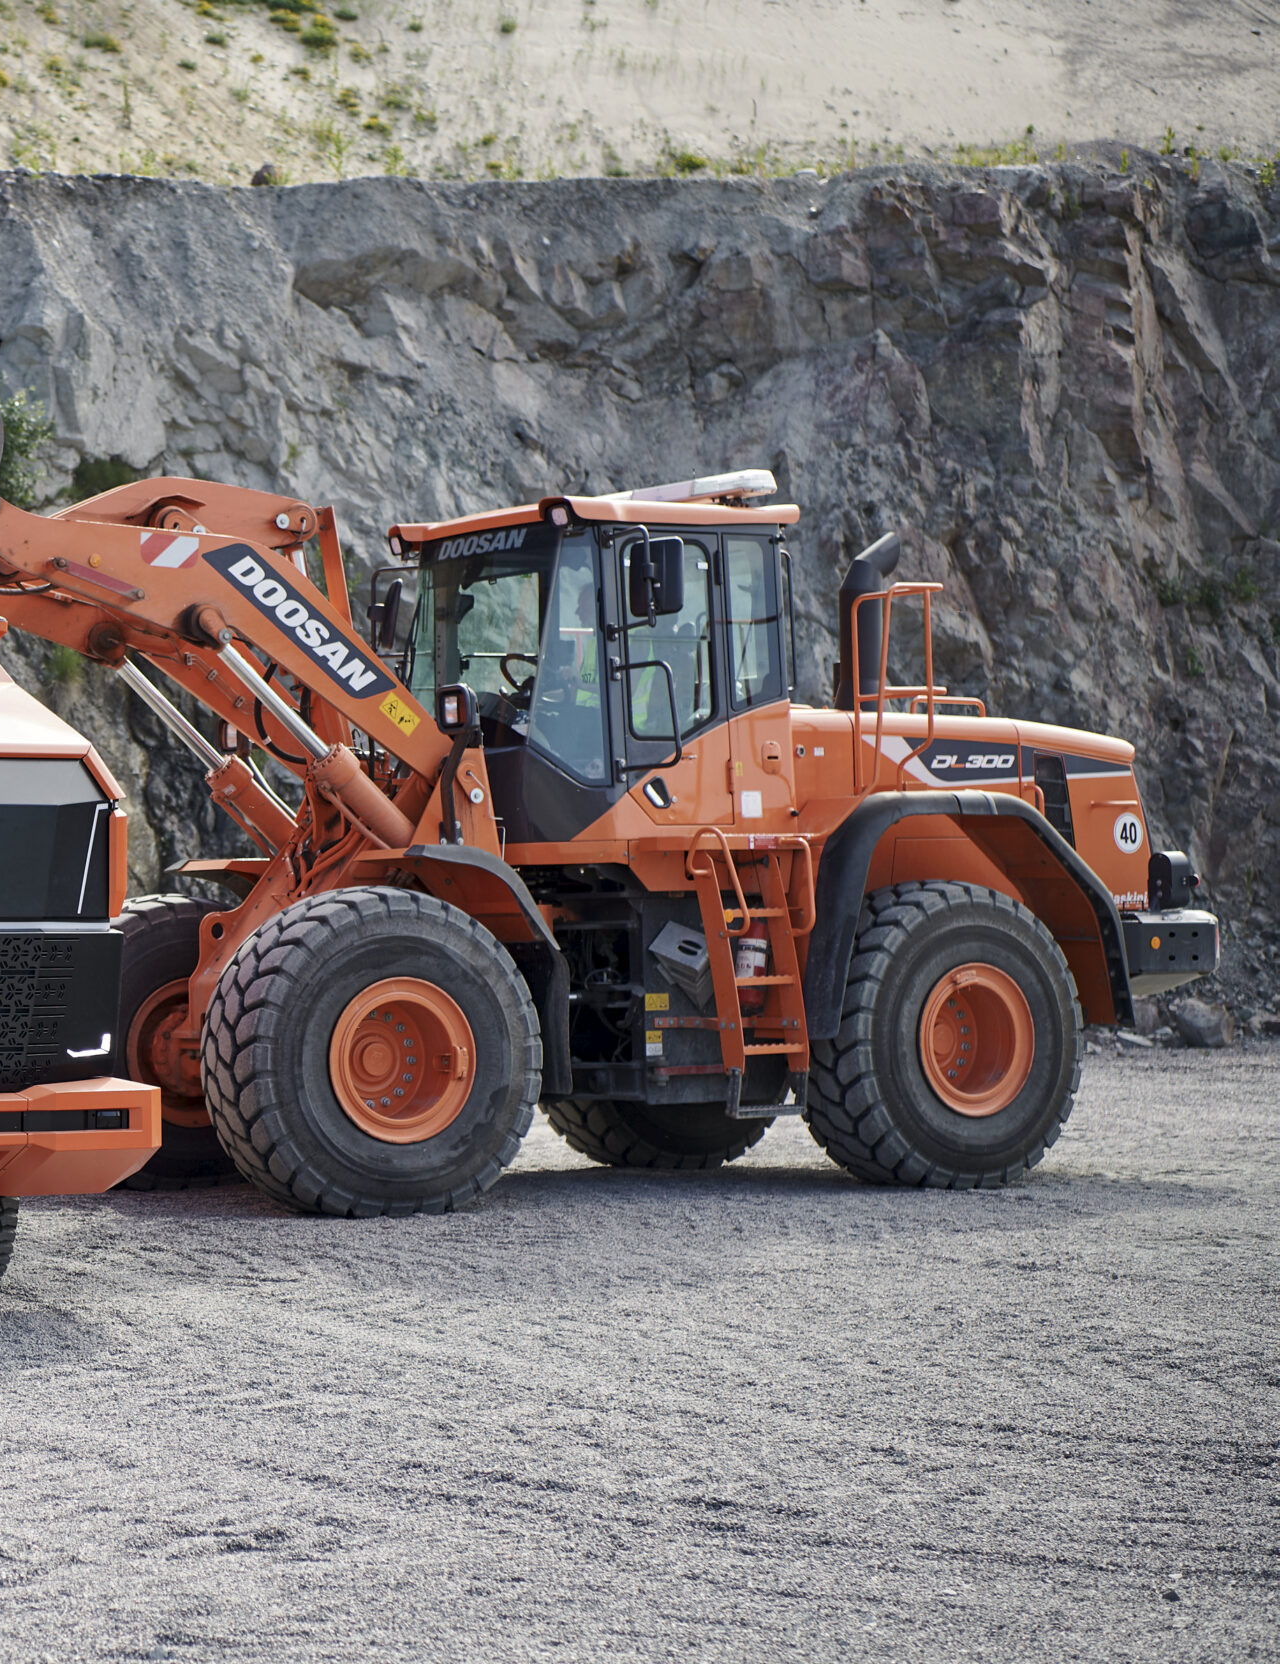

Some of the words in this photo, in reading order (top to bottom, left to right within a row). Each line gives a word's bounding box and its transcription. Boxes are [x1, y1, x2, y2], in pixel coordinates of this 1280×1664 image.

[438, 527, 528, 561] DOOSAN
[227, 555, 377, 692] DOOSAN
[931, 754, 1016, 769] DL300
[1120, 822, 1137, 844] 40
